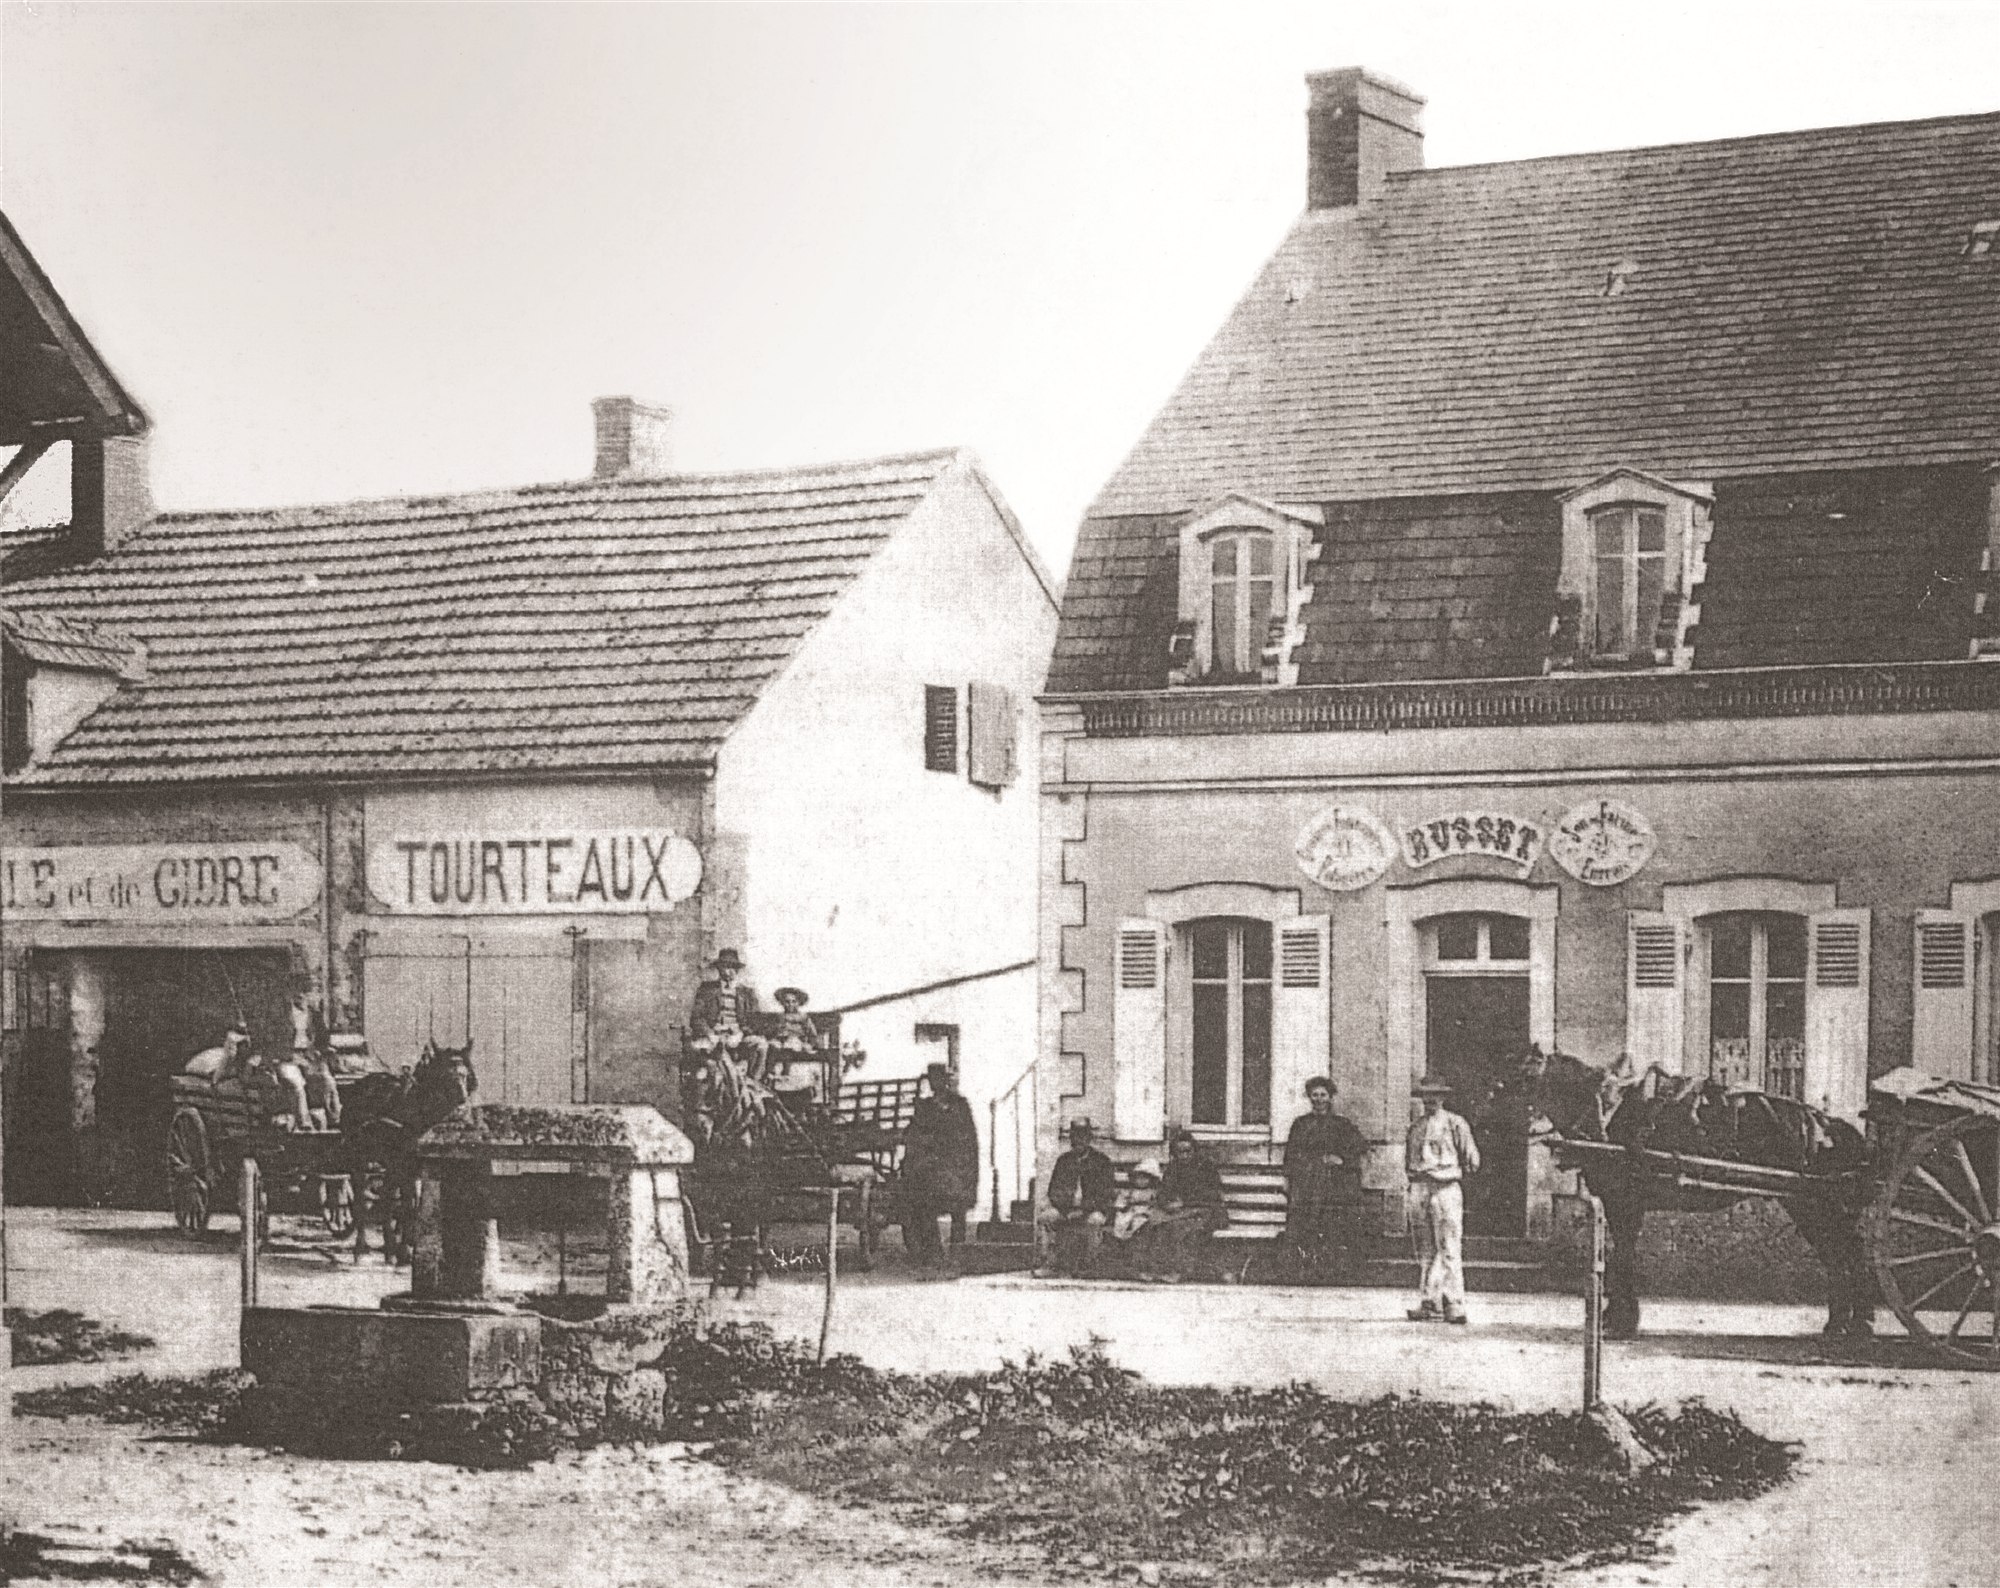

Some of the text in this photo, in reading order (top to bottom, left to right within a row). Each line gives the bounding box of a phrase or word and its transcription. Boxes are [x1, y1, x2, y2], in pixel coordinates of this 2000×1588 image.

[1405, 816, 1538, 863] BUSSET
[154, 855, 279, 908] CIDRE
[395, 836, 670, 903] TOURTEAUX
